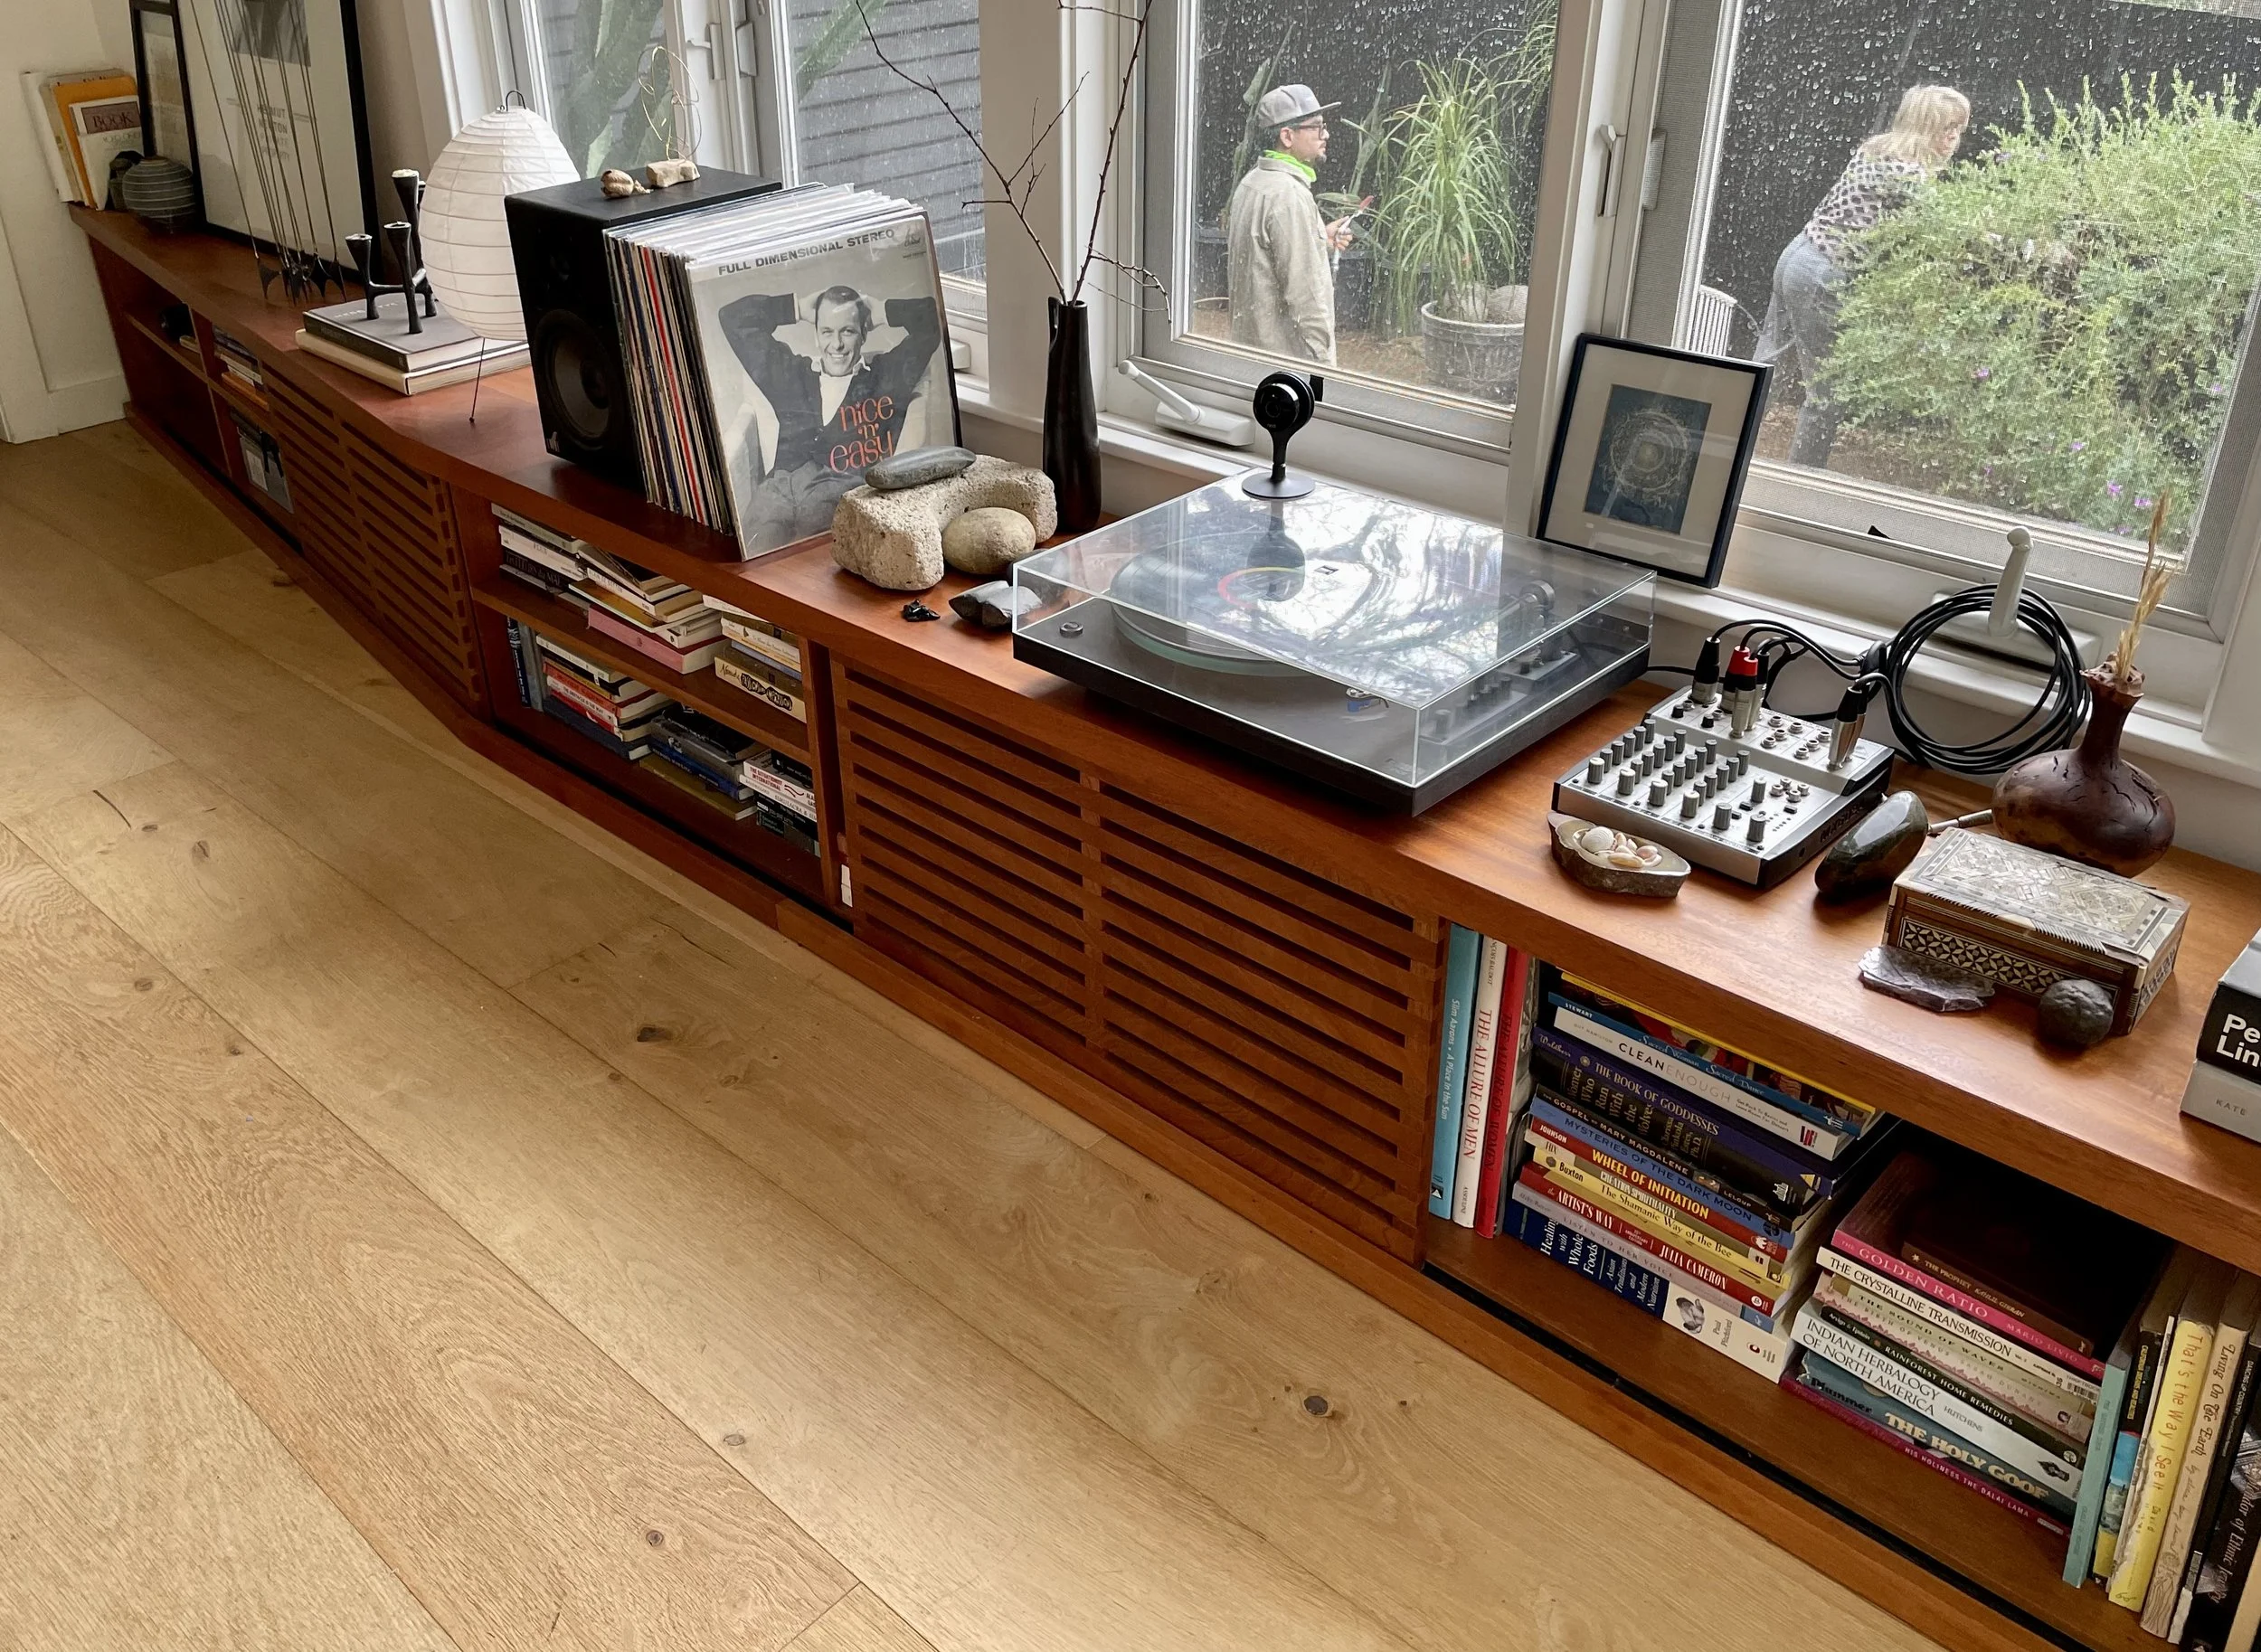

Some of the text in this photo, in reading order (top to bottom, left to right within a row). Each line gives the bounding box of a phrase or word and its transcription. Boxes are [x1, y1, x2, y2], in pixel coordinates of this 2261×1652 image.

[92, 111, 135, 127] BOOK
[718, 261, 751, 275] FULL
[755, 241, 844, 268] DIMENSIONAL
[847, 229, 894, 247] STEREO
[839, 395, 894, 431] nice
[829, 430, 894, 473] easy
[1452, 998, 1461, 1016] Slim
[1566, 1003, 1593, 1019] STEWART
[2216, 1034, 2261, 1068] Lin
[1463, 1010, 1492, 1160] THE ALLURE OF MEN
[1594, 1062, 1719, 1136] THE BOOK OF GODDESSES
[2216, 1099, 2247, 1115] KATE
[1539, 1124, 1567, 1144] JOHNSON
[1554, 1099, 1589, 1121] GOSPEL
[1600, 1123, 1625, 1140] MARY
[1629, 1138, 1689, 1175] MAGDALENE
[1564, 1118, 1752, 1222] MYSTERIES OF THE DARK MOON
[1592, 1148, 1710, 1221] WHEEL OF INITIATION
[1556, 1190, 1594, 1219] ARTIST'S
[1595, 1209, 1615, 1231] WAY
[1559, 1162, 1732, 1258] Buxton The Shamanic Way of the Bee
[1601, 1171, 1677, 1219] CREATION SPIRITUALITY
[1559, 1233, 1568, 1251] with
[1564, 1216, 1673, 1279] LISTEN TO HER VOICE
[1568, 1233, 1584, 1267] Whole
[1583, 1242, 1599, 1275] Foods
[1605, 1259, 1616, 1280] Asian
[1613, 1258, 1628, 1294] Traditions
[1629, 1272, 1637, 1289] and
[1660, 1244, 1728, 1290] JULIA CAMERON
[1925, 1260, 1939, 1272] THE
[1940, 1268, 1972, 1289] PROPHET
[1636, 1273, 1650, 1302] Modern
[1859, 1248, 1928, 1289] GOLDEN
[1933, 1285, 1988, 1317] RATIO
[2007, 1323, 2044, 1345] MARIO
[2047, 1344, 2078, 1363] LIVIO
[1830, 1257, 2012, 1356] THE CRYSTALLINE TRANSMISSION
[1712, 1319, 1722, 1336] Paul
[1859, 1294, 1883, 1310] THE
[1889, 1310, 1933, 1336] SOUND
[1962, 1346, 2004, 1371] WAVES
[1807, 1318, 1941, 1402] INDIAN HERBALOGY
[2178, 1333, 2204, 1379] That's
[2213, 1344, 2237, 1381] Living
[1802, 1333, 1822, 1348] OF
[1823, 1344, 1873, 1380] NORTH
[1875, 1375, 1935, 1417] AMERICA
[1885, 1345, 1937, 1381] RAINFOREST
[1940, 1378, 1967, 1399] HOME
[1970, 1397, 2014, 1426] REMEDIES
[2209, 1383, 2225, 1400] On
[2172, 1383, 2190, 1407] the
[1944, 1405, 1983, 1432] HUTCHENS
[2159, 1409, 2185, 1440] Way
[1811, 1377, 1873, 1414] Plummer
[1884, 1411, 1928, 1443] THE
[1931, 1435, 1987, 1470] HOLY
[1988, 1464, 2050, 1500] GOOF
[2191, 1427, 2213, 1457] Earth
[1905, 1447, 2029, 1518] HIS HOLINESS THE DALAI LAMA
[2153, 1455, 2171, 1481] See
[2229, 1516, 2247, 1534] of
[2223, 1533, 2245, 1568] Ethnic
